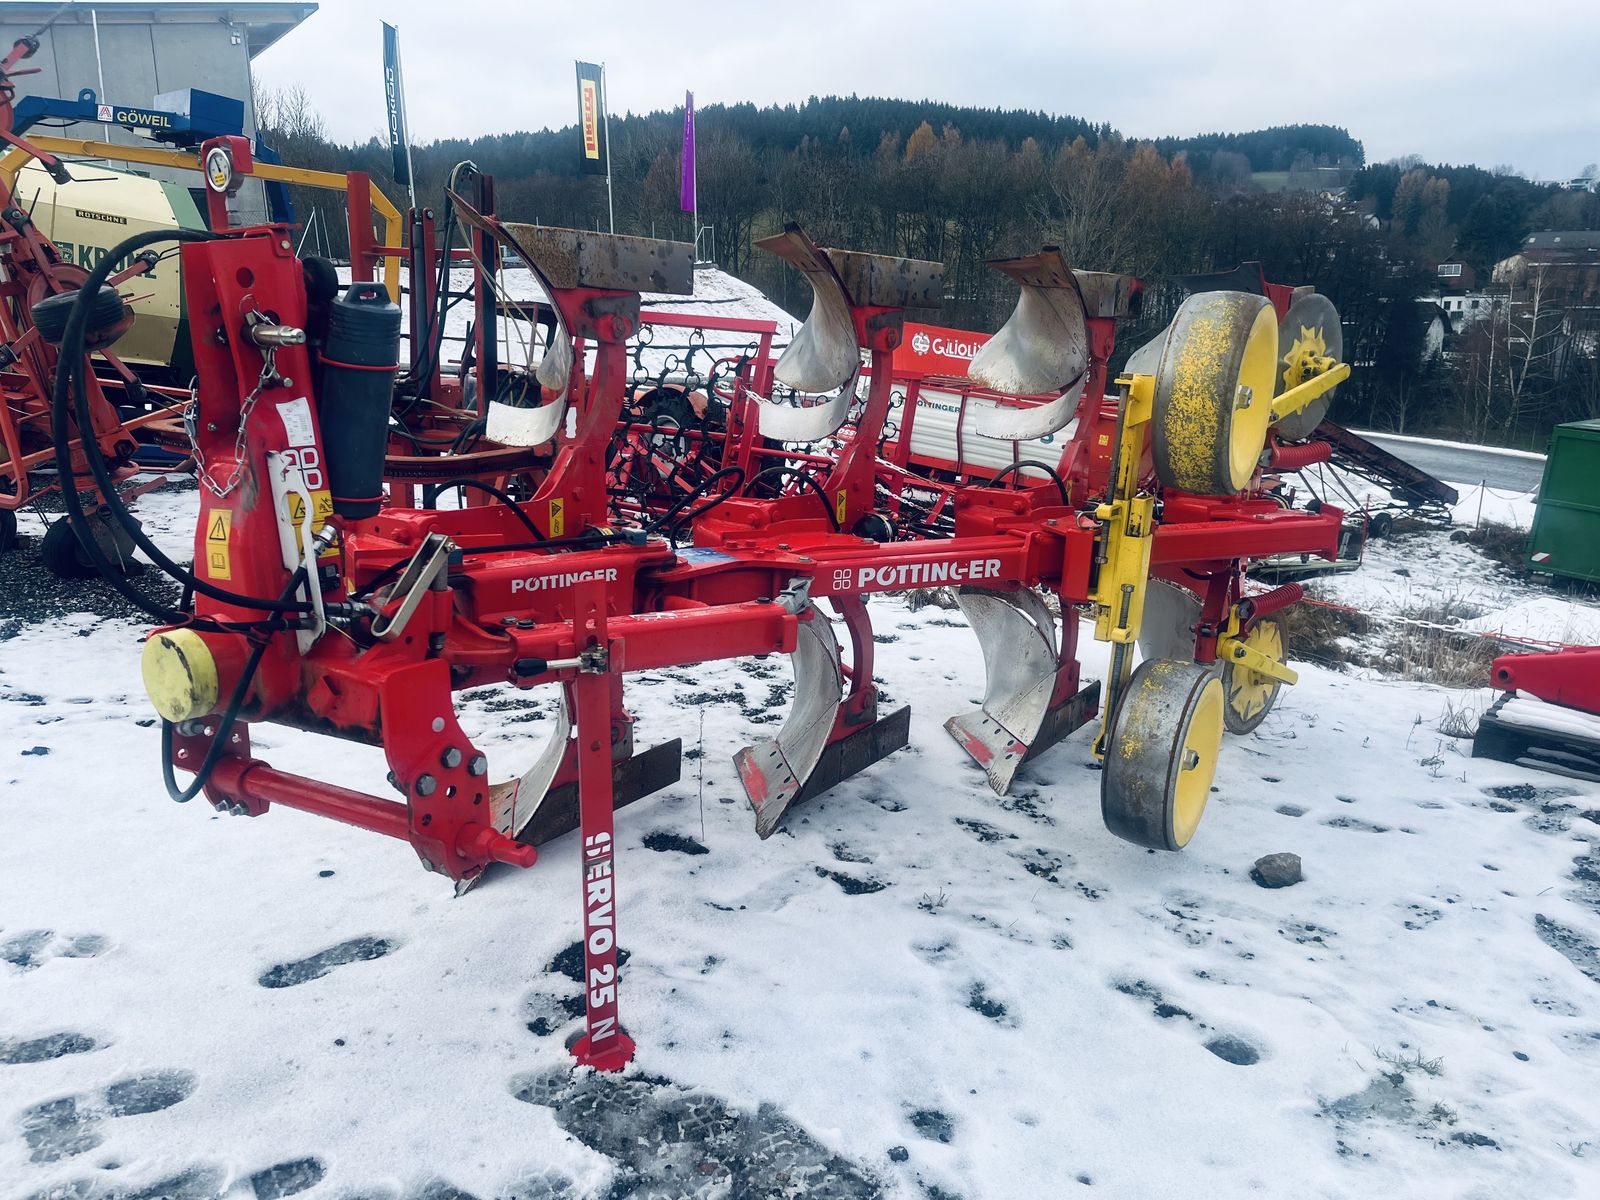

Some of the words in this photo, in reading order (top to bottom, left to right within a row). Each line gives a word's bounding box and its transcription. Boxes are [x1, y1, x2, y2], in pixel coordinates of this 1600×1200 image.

[117, 110, 172, 127] GÖWEIL
[511, 568, 618, 593] PÖTTINGER
[858, 559, 1001, 588] PÖTTINGER
[585, 831, 614, 955] SERVO
[590, 963, 615, 1009] 25
[591, 1017, 617, 1043] N
